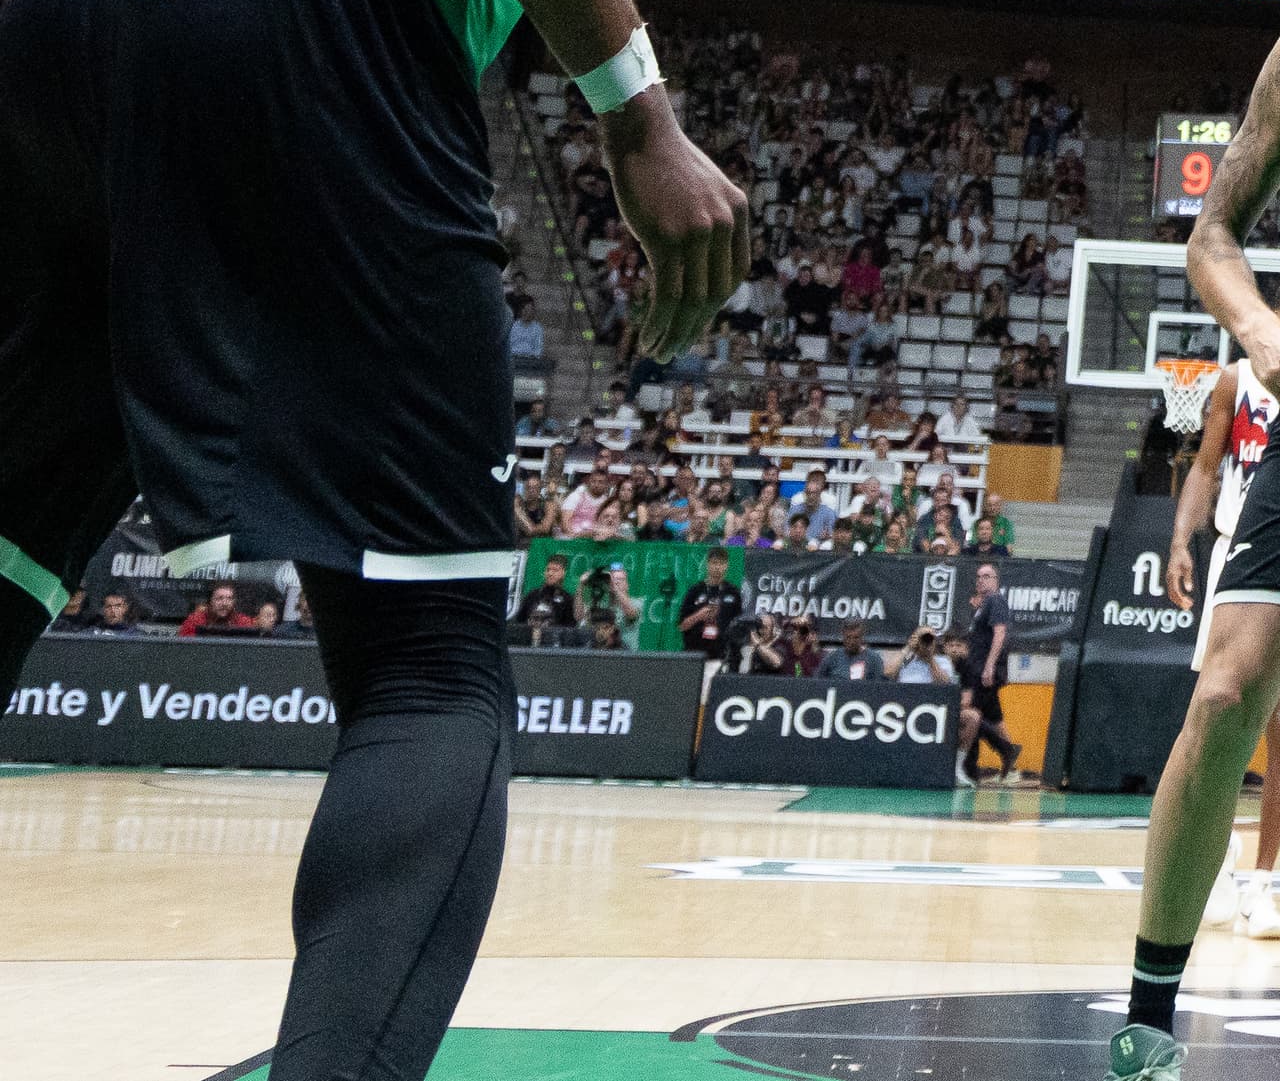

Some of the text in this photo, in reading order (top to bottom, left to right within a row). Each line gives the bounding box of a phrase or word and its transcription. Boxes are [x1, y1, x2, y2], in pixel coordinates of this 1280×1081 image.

[1177, 119, 1232, 143] 1:26
[1181, 151, 1213, 196] 9
[1102, 599, 1195, 634] flexygo
[97, 690, 128, 727] y
[714, 686, 948, 745] endesa
